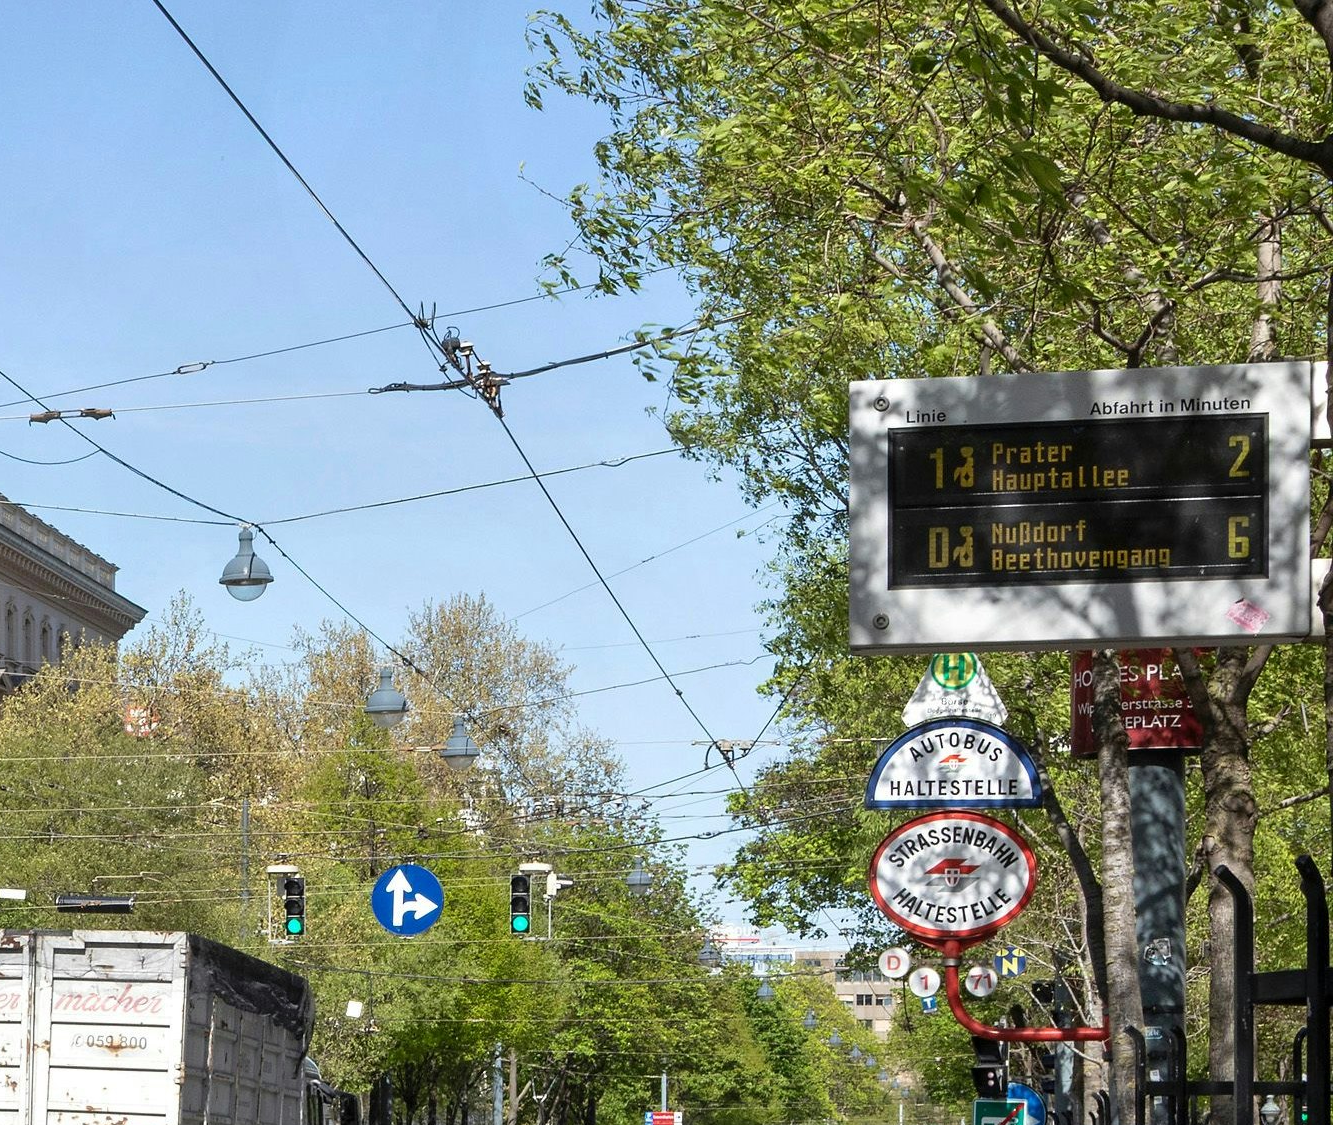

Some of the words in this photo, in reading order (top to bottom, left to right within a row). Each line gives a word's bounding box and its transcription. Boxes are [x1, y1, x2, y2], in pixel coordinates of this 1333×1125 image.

[906, 410, 947, 424] Linie
[1090, 400, 1154, 416] Abfahrt
[1159, 399, 1174, 414] in
[1180, 397, 1251, 412] Minuten
[991, 443, 1073, 465] Prater
[1228, 435, 1250, 478] 2
[929, 447, 943, 489] 1
[992, 466, 1130, 492] Hauptallee
[991, 520, 1087, 546] Nußdorf
[1228, 516, 1250, 559] 6
[991, 547, 1171, 571] Beethovengang
[909, 732, 1003, 762] AUTOBUS
[890, 779, 1018, 797] HALTESTELLE
[889, 826, 1019, 869] STRASSENBAHN
[893, 888, 1012, 923] HALTESTELLE
[887, 955, 901, 970] D
[1002, 958, 1018, 975] N
[920, 975, 929, 990] 1
[970, 973, 992, 990] 71
[54, 984, 162, 1014] macher
[120, 1035, 147, 1050] 800
